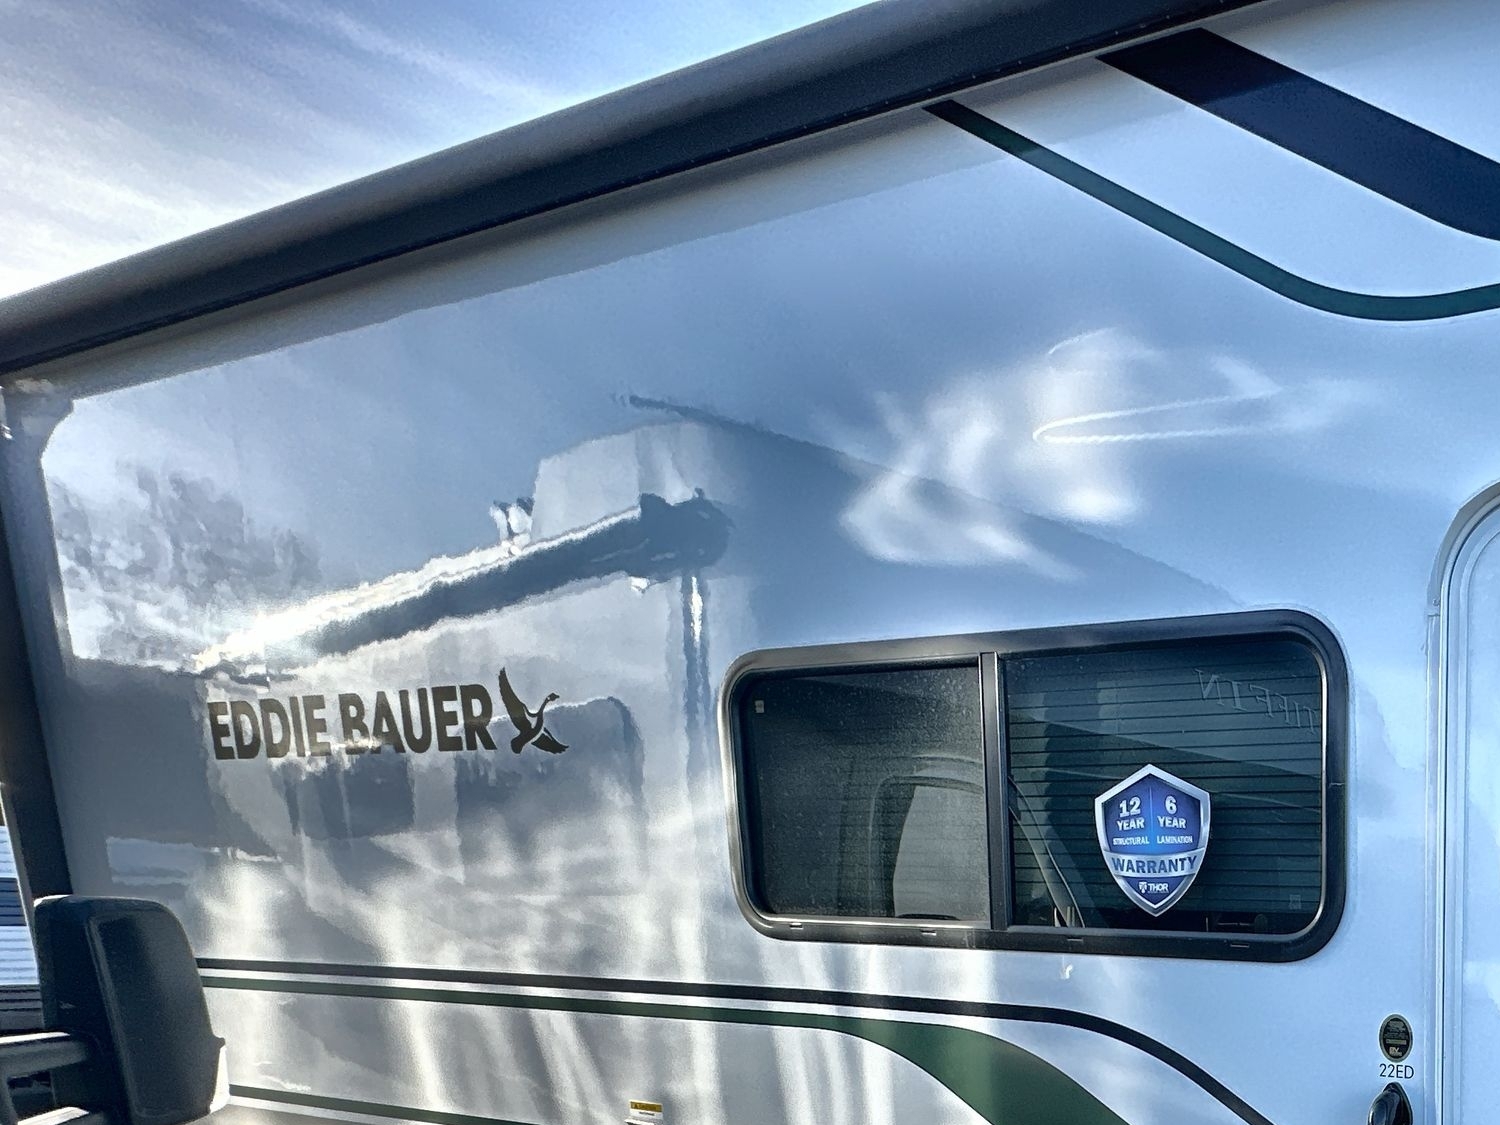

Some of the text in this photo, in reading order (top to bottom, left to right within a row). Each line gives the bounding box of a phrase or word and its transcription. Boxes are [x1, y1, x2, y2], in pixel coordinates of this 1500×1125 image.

[208, 683, 498, 760] EDDIE BAUER
[1119, 796, 1142, 818] 12
[1164, 795, 1178, 815] 6
[1116, 817, 1145, 831] YEAR
[1157, 815, 1187, 829] YEAR
[1112, 835, 1150, 846] STRUCTURAL
[1156, 835, 1193, 845] LAMINATION
[1111, 854, 1198, 874] WARRANTY
[1147, 882, 1169, 892] THOR
[1379, 1063, 1415, 1079] 22ED
